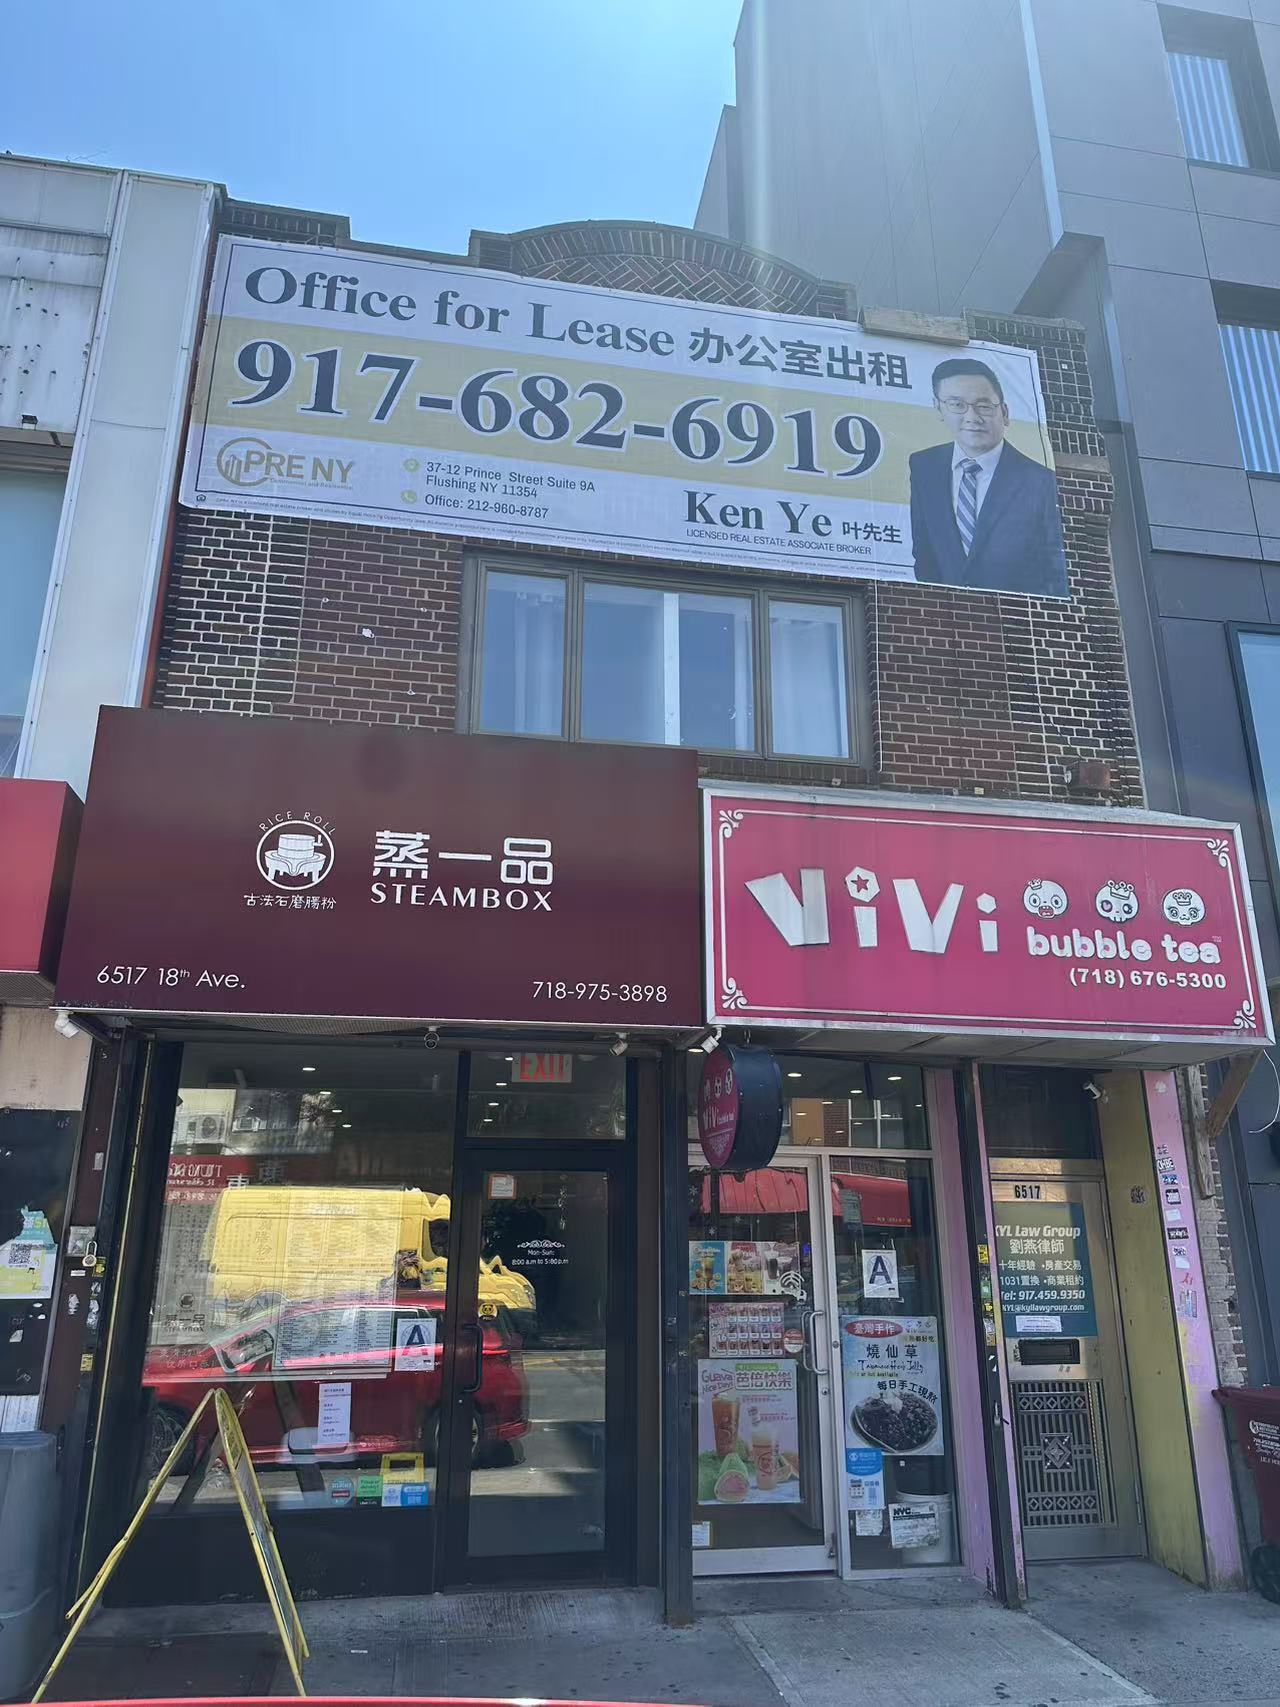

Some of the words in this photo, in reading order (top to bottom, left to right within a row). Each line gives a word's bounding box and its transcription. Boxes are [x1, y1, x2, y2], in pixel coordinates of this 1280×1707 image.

[245, 266, 417, 321] Office
[433, 291, 510, 334] for
[526, 301, 675, 356] Lease
[688, 327, 913, 390] 办公室出租
[229, 339, 884, 477] 917-682-6919
[311, 457, 354, 483] NY
[426, 462, 461, 475] 37-12
[464, 466, 502, 481] Prince
[509, 472, 544, 486] Street
[547, 477, 576, 490] Suite
[580, 481, 596, 493] 9A
[426, 475, 476, 493] Flushing
[480, 482, 498, 494] NY
[501, 485, 538, 499] 11354
[425, 494, 464, 509] Office:
[467, 499, 549, 518] 212-960-8787
[683, 490, 765, 531] Ken
[776, 501, 833, 537] Ye
[686, 529, 729, 541] LICENSED
[730, 533, 751, 544] REAL
[753, 536, 786, 548] ESTATE
[787, 539, 835, 552] ASSOCIATE
[836, 544, 872, 555] BROKER
[842, 521, 903, 544] 叶先生
[259, 811, 293, 832] RICE
[303, 812, 336, 836] ROLL
[372, 830, 554, 886] 蒸一品
[243, 892, 337, 910] 古法石磨腸粉
[370, 882, 553, 911] STEAMBOX
[1026, 925, 1153, 962] bubble
[1160, 933, 1222, 964] tea
[96, 965, 149, 985] 6517
[157, 967, 191, 987] 18th
[195, 969, 246, 989] Ave.
[1069, 967, 1126, 989] (718)
[1129, 970, 1228, 989] 676-5300
[532, 981, 668, 1003] 718-975-3898
[1014, 1184, 1042, 1200] 6517
[1014, 1225, 1041, 1237] Law
[1042, 1225, 1082, 1239] Group
[1009, 1238, 1065, 1255] 劉燕律師
[869, 1255, 892, 1285] A
[1018, 1289, 1086, 1300] 917.459.9350
[402, 1324, 429, 1356] A
[866, 1343, 919, 1359] 燒仙草
[702, 1369, 734, 1383] Guava
